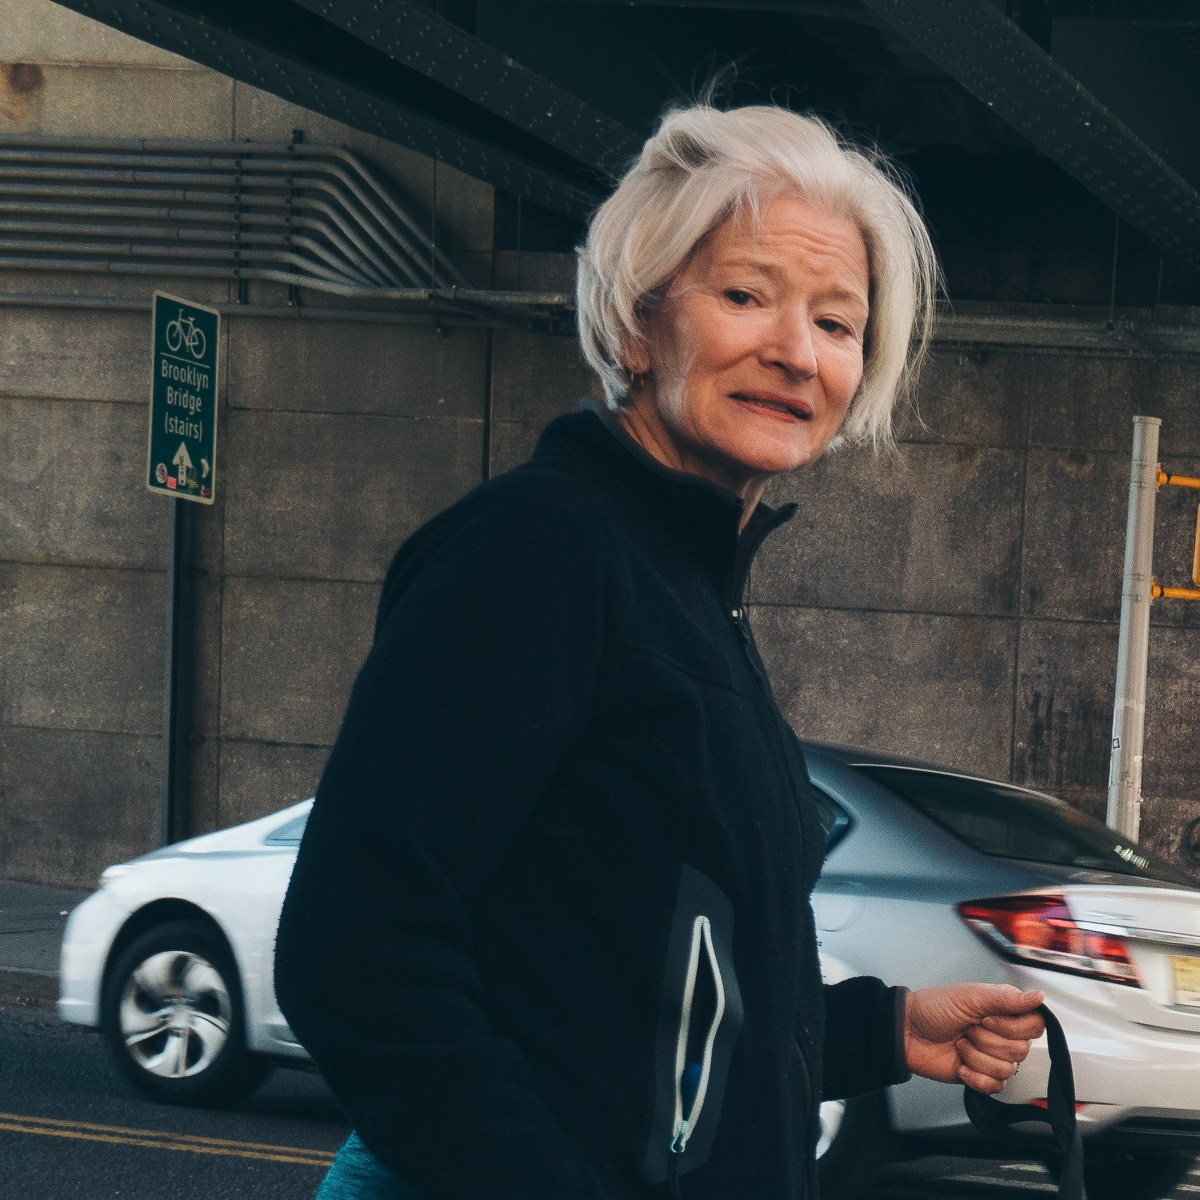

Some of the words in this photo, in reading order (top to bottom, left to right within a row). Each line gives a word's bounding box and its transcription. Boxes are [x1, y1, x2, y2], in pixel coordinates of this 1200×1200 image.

[161, 359, 209, 392] Brooklyn
[167, 386, 202, 415] Bridge
[164, 411, 203, 442] (stairs)
